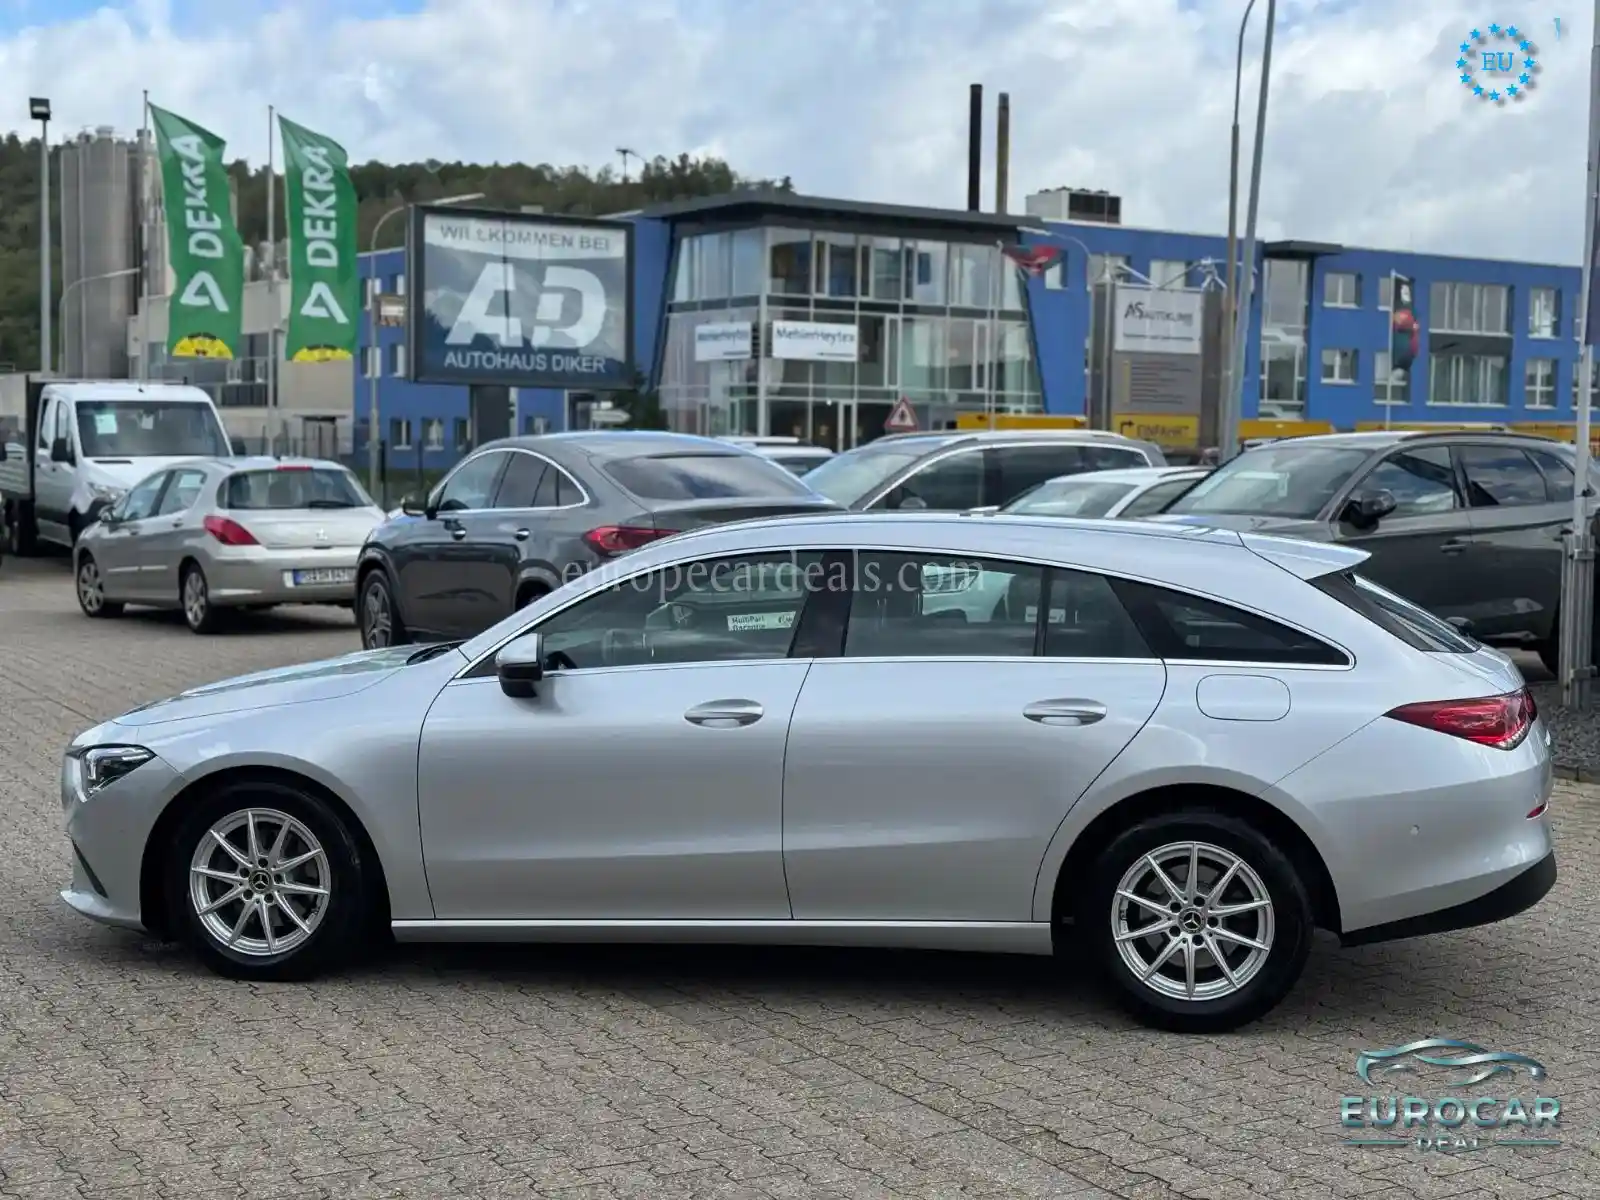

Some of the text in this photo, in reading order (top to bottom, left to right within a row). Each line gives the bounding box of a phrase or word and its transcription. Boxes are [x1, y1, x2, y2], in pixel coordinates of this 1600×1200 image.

[168, 133, 225, 260] DEKRA
[300, 143, 340, 269] DEKRA
[440, 224, 612, 252] WILLKOMMEN BEI
[444, 261, 607, 349] AD
[444, 351, 607, 374] AUTOHAUS DIKER
